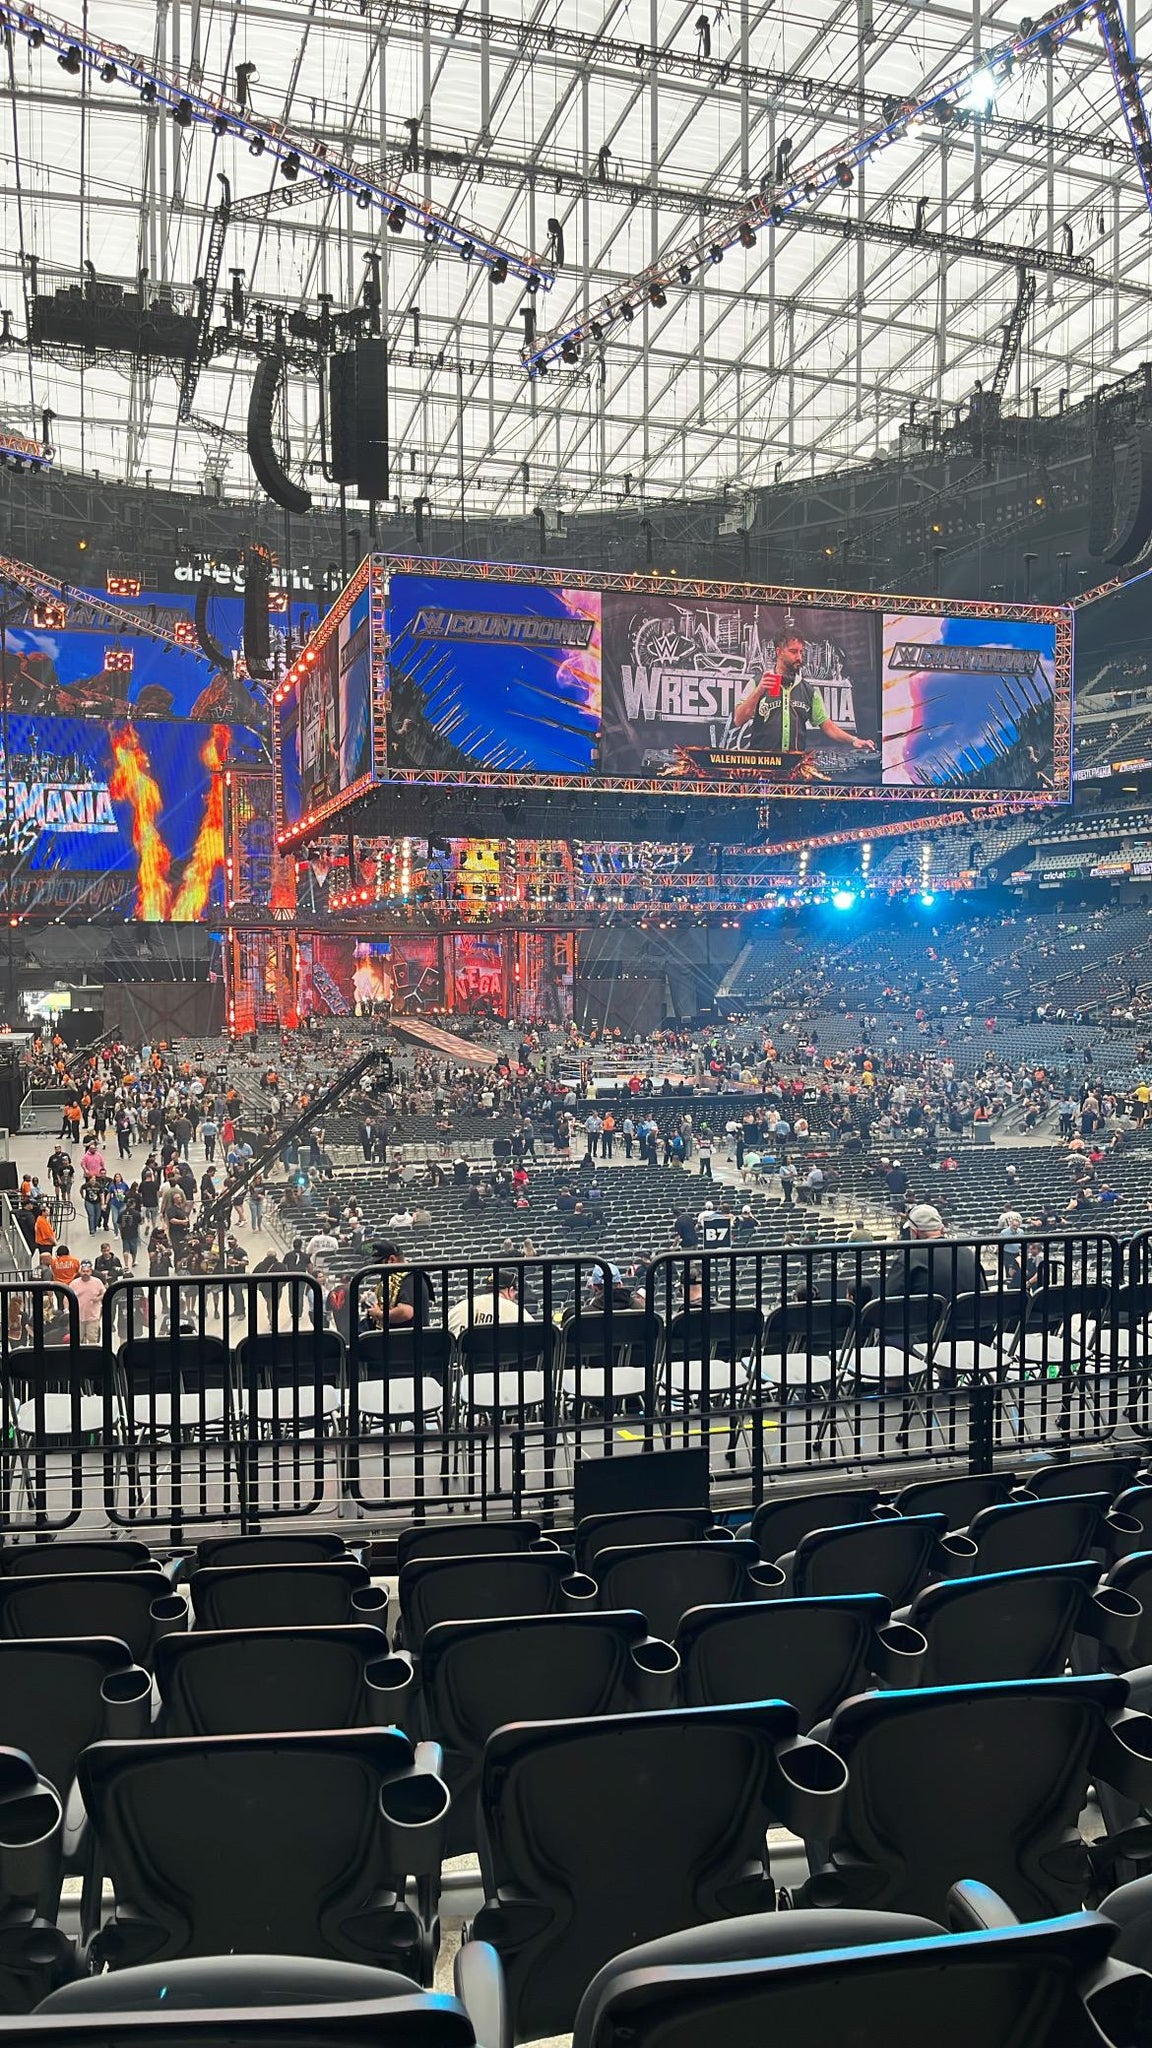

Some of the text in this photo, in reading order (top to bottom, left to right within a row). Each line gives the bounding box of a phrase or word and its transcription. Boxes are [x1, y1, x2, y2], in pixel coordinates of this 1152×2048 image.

[451, 615, 588, 644] COUNTDOWN
[710, 754, 782, 766] VALENTINO KHAN
[804, 1091, 816, 1100] A6
[705, 1228, 729, 1241] B7
